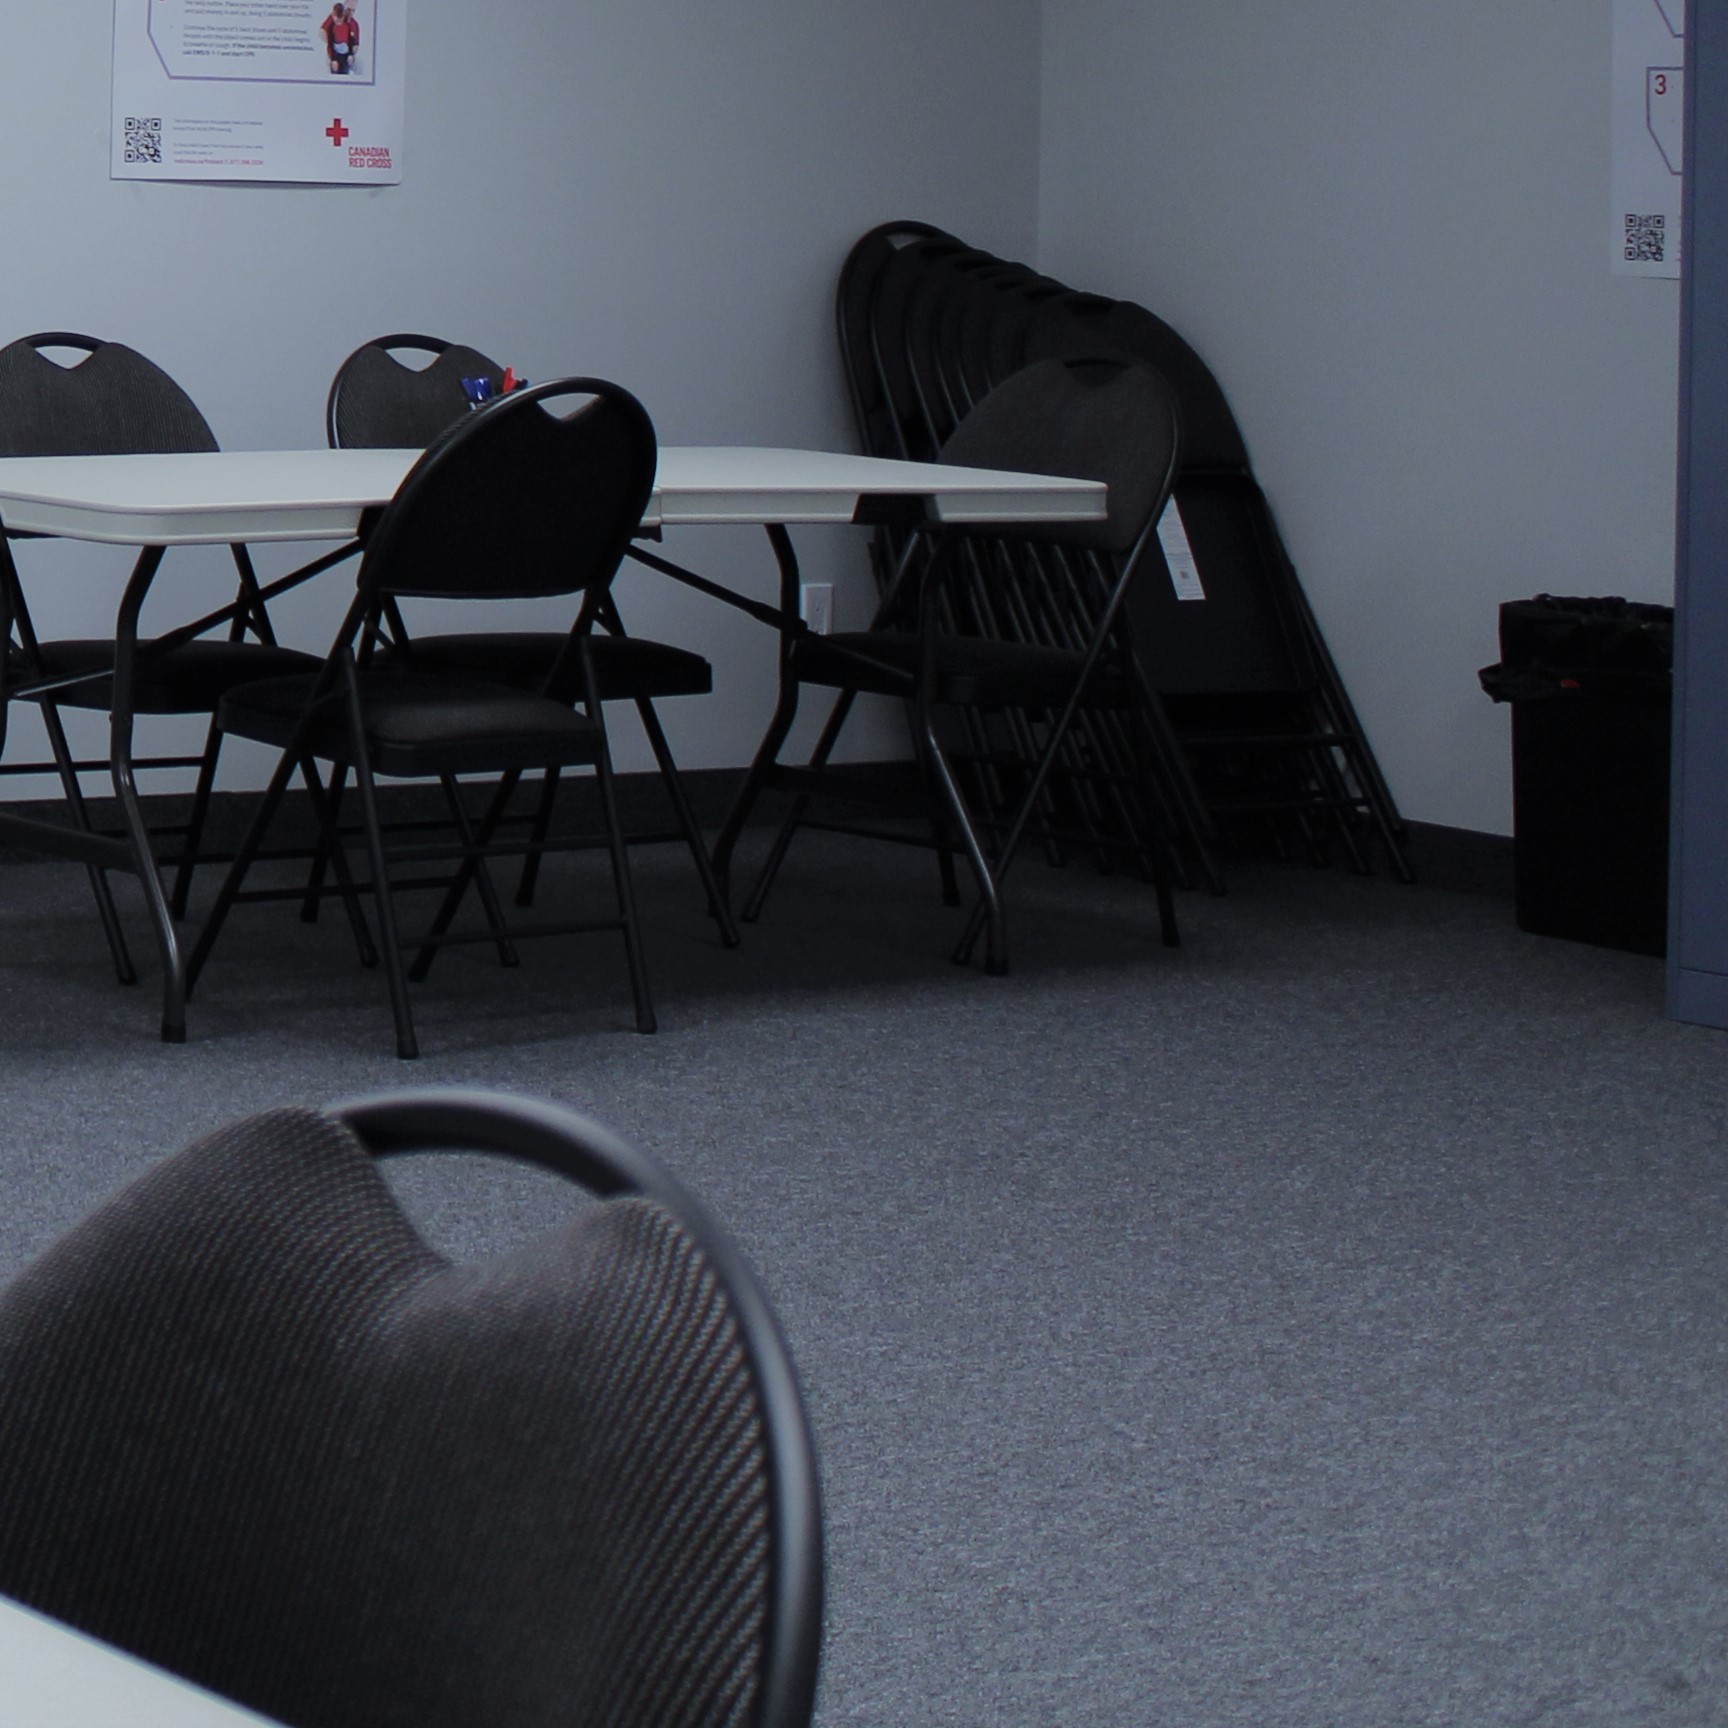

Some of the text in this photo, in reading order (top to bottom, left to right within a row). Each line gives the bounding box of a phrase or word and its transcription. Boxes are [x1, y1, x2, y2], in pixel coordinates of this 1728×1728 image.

[1654, 75, 1667, 96] 3
[348, 146, 389, 157] CANADIAN
[349, 157, 392, 169] RED CROSS
